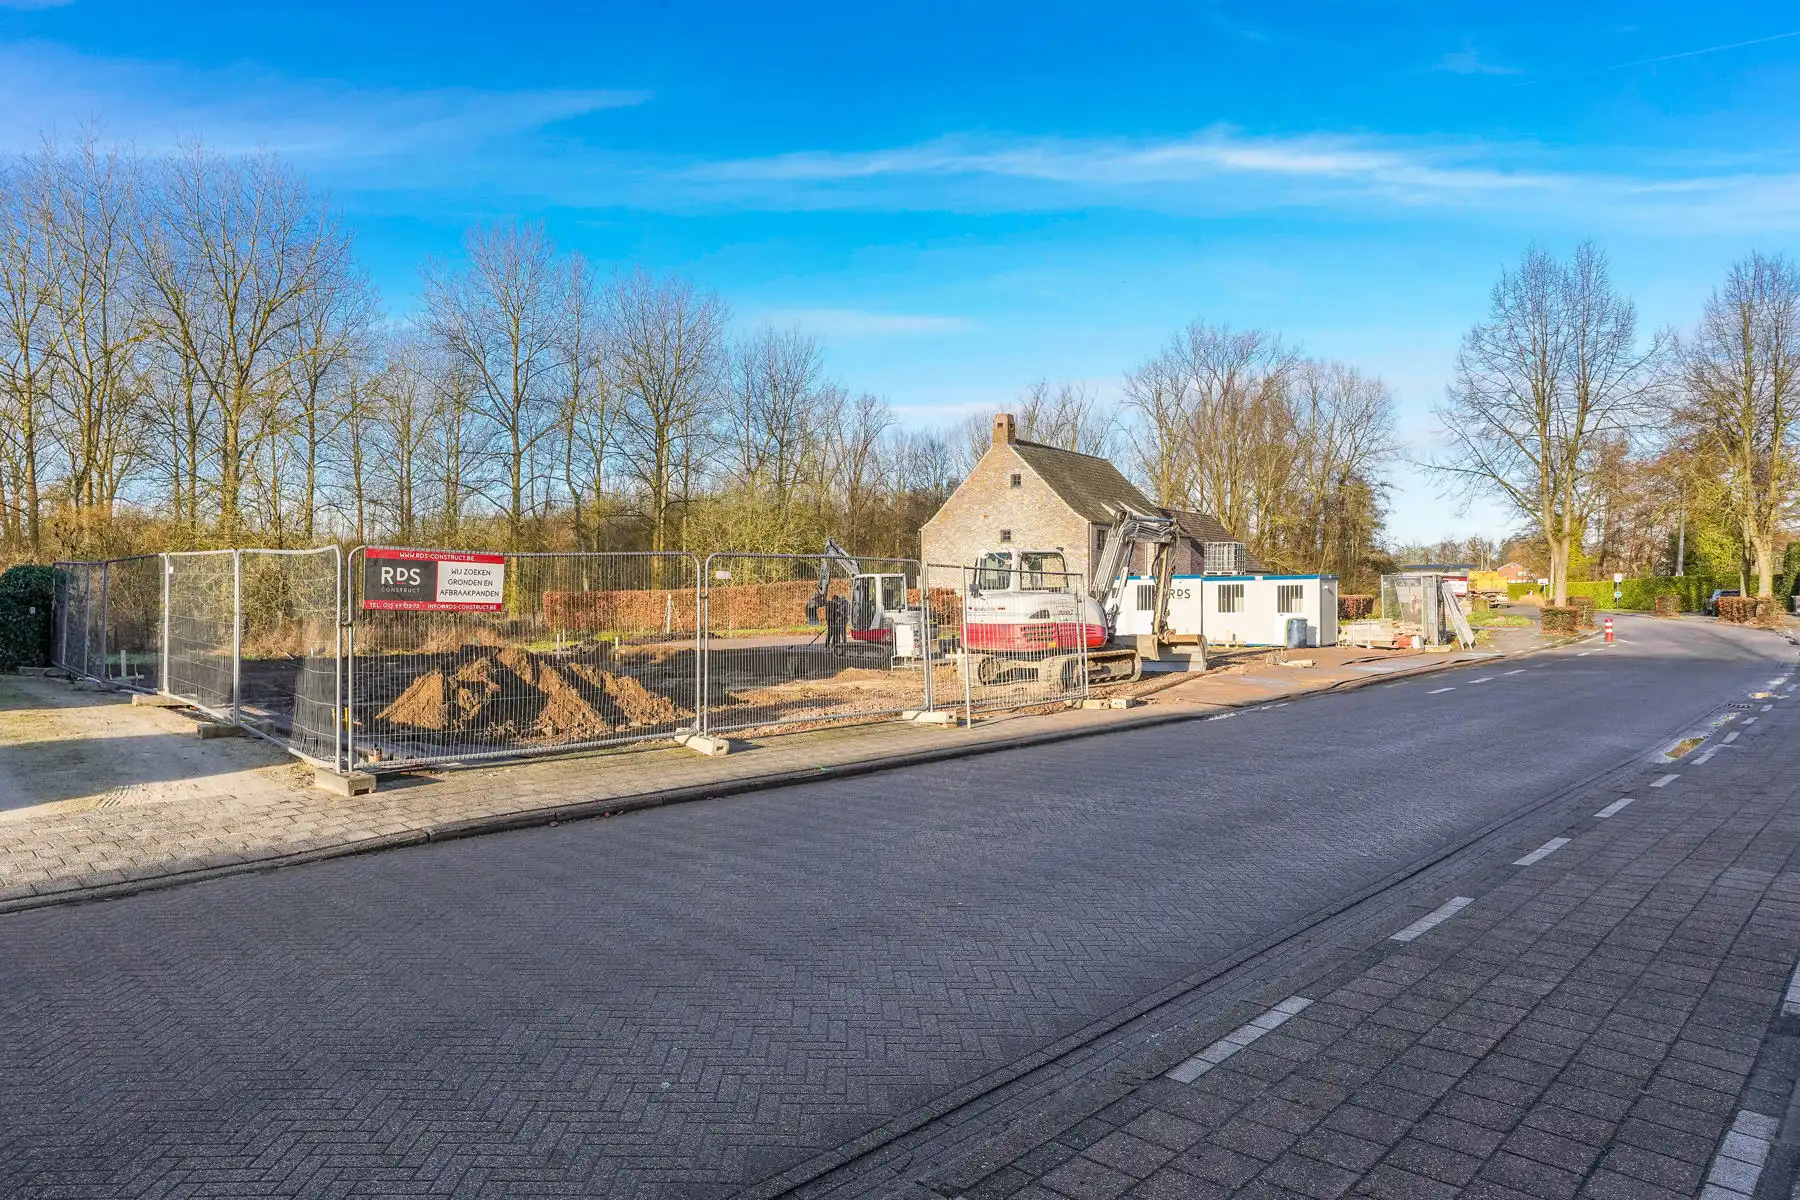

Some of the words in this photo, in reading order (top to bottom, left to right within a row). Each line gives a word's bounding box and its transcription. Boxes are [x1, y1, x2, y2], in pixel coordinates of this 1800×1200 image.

[400, 552, 475, 562] WWW.RDS-CONSTRUCT.BE
[381, 566, 421, 586] RDS
[464, 568, 491, 576] ZOEKEN
[440, 589, 499, 597] AFBRAAKPANDEN
[1170, 588, 1190, 600] RDS
